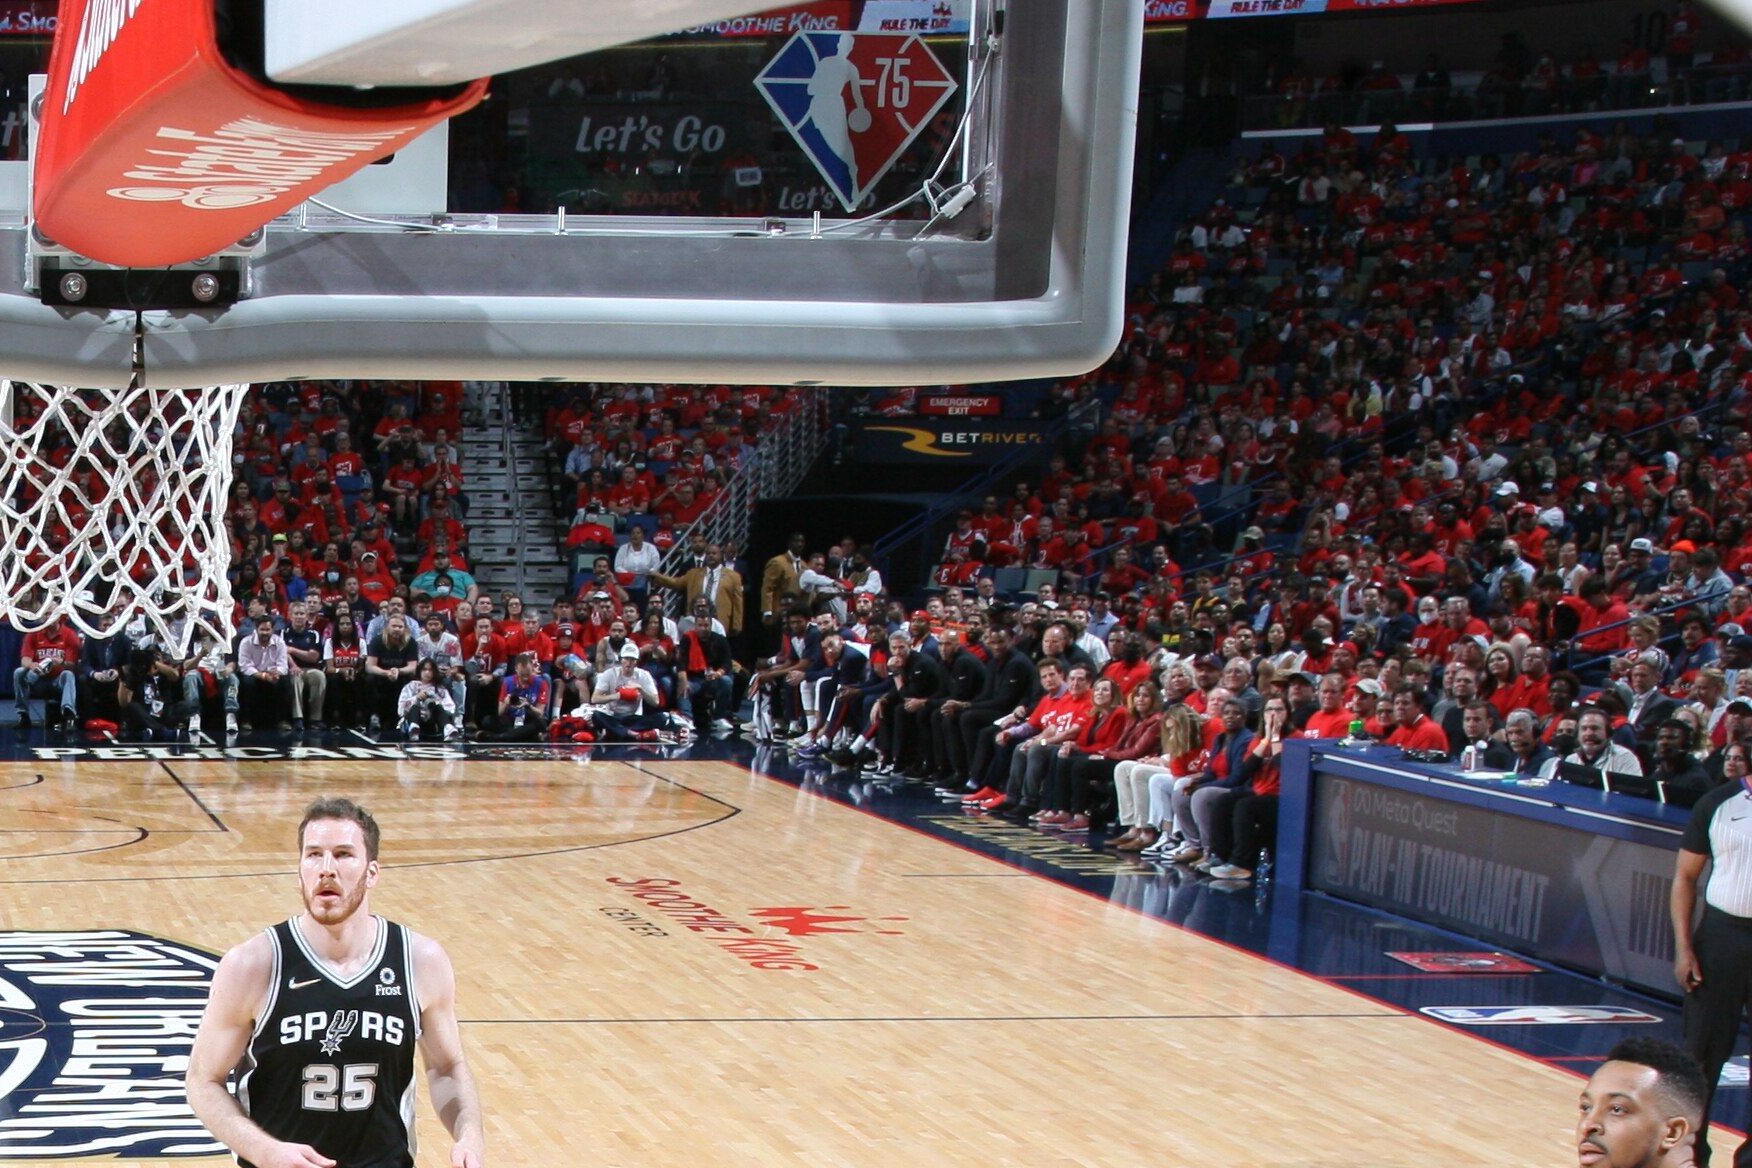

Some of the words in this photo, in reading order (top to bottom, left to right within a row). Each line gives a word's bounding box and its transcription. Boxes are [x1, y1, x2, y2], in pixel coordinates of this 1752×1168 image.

[908, 18, 928, 30] THE
[875, 57, 912, 109] 75
[575, 115, 664, 152] Let's
[672, 115, 726, 152] Go
[929, 397, 989, 408] EMERGENCY
[947, 407, 969, 416] EXIT
[32, 747, 469, 761] PELICANS
[1372, 799, 1412, 828] Meta
[1412, 806, 1459, 837] Quest
[1348, 826, 1418, 896] PLAY-IN
[1418, 841, 1549, 944] TOURNAMENT
[598, 906, 669, 938] CENTER
[605, 876, 754, 934] SMOOTHIE
[375, 984, 403, 996] Frost
[280, 1010, 405, 1057] SPURS
[301, 1063, 380, 1113] 25
